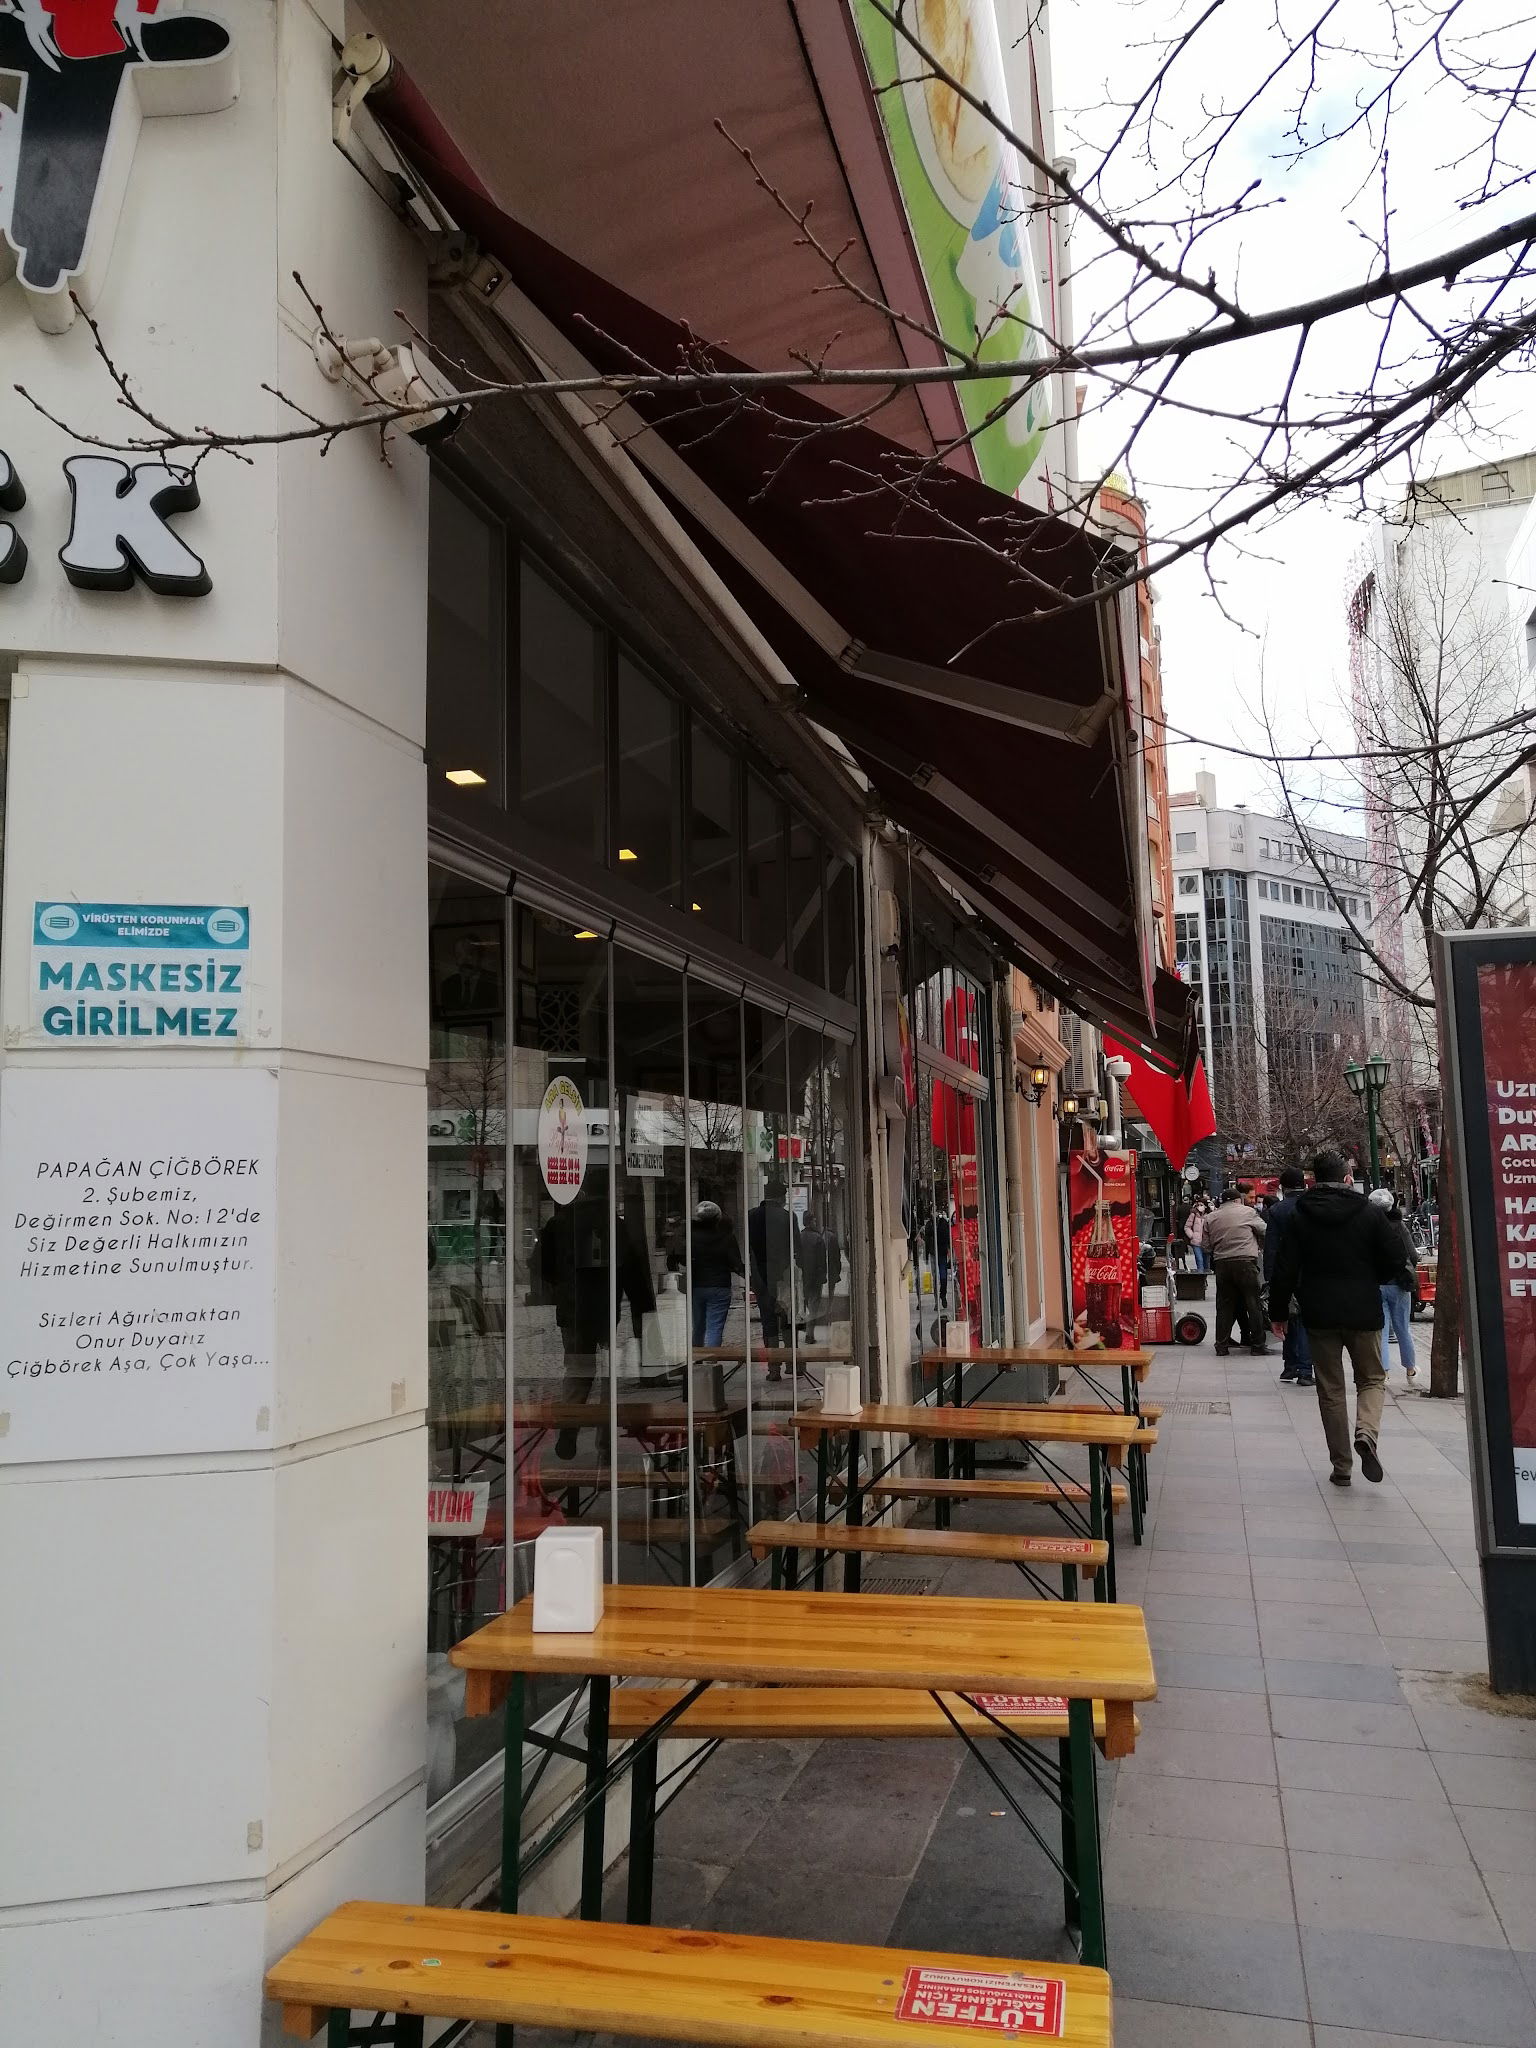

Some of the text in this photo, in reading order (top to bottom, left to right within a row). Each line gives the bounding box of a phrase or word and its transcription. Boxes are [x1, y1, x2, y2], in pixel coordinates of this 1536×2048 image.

[82, 913, 205, 926] VİRÜSTEN KORUNMAK
[117, 925, 170, 937] ELİMİZDE
[39, 957, 242, 993] MASKESİZ
[42, 999, 238, 1037] GİRİLMEZ
[37, 1156, 260, 1179] PAPAĞAN ÇİĞBÖREK
[82, 1186, 197, 1205] 2. Şubemiz,
[14, 1208, 261, 1231] Değirmen Sok. No: 12'de
[27, 1233, 248, 1254] Siz Değerli Halkımızın
[20, 1256, 254, 1277] Hizmetine Sunulmuştur.
[38, 1308, 241, 1328] Sizleri Ağırlamaktan
[75, 1331, 206, 1350] Onur Duyarız
[6, 1357, 102, 1378] Çiğbörek
[109, 1355, 152, 1373] Aşa,
[159, 1353, 197, 1372] Çok
[915, 1989, 1046, 2010] SAĞLIĞINIZ İÇİN
[911, 2000, 1045, 2029] LÜTFEN
